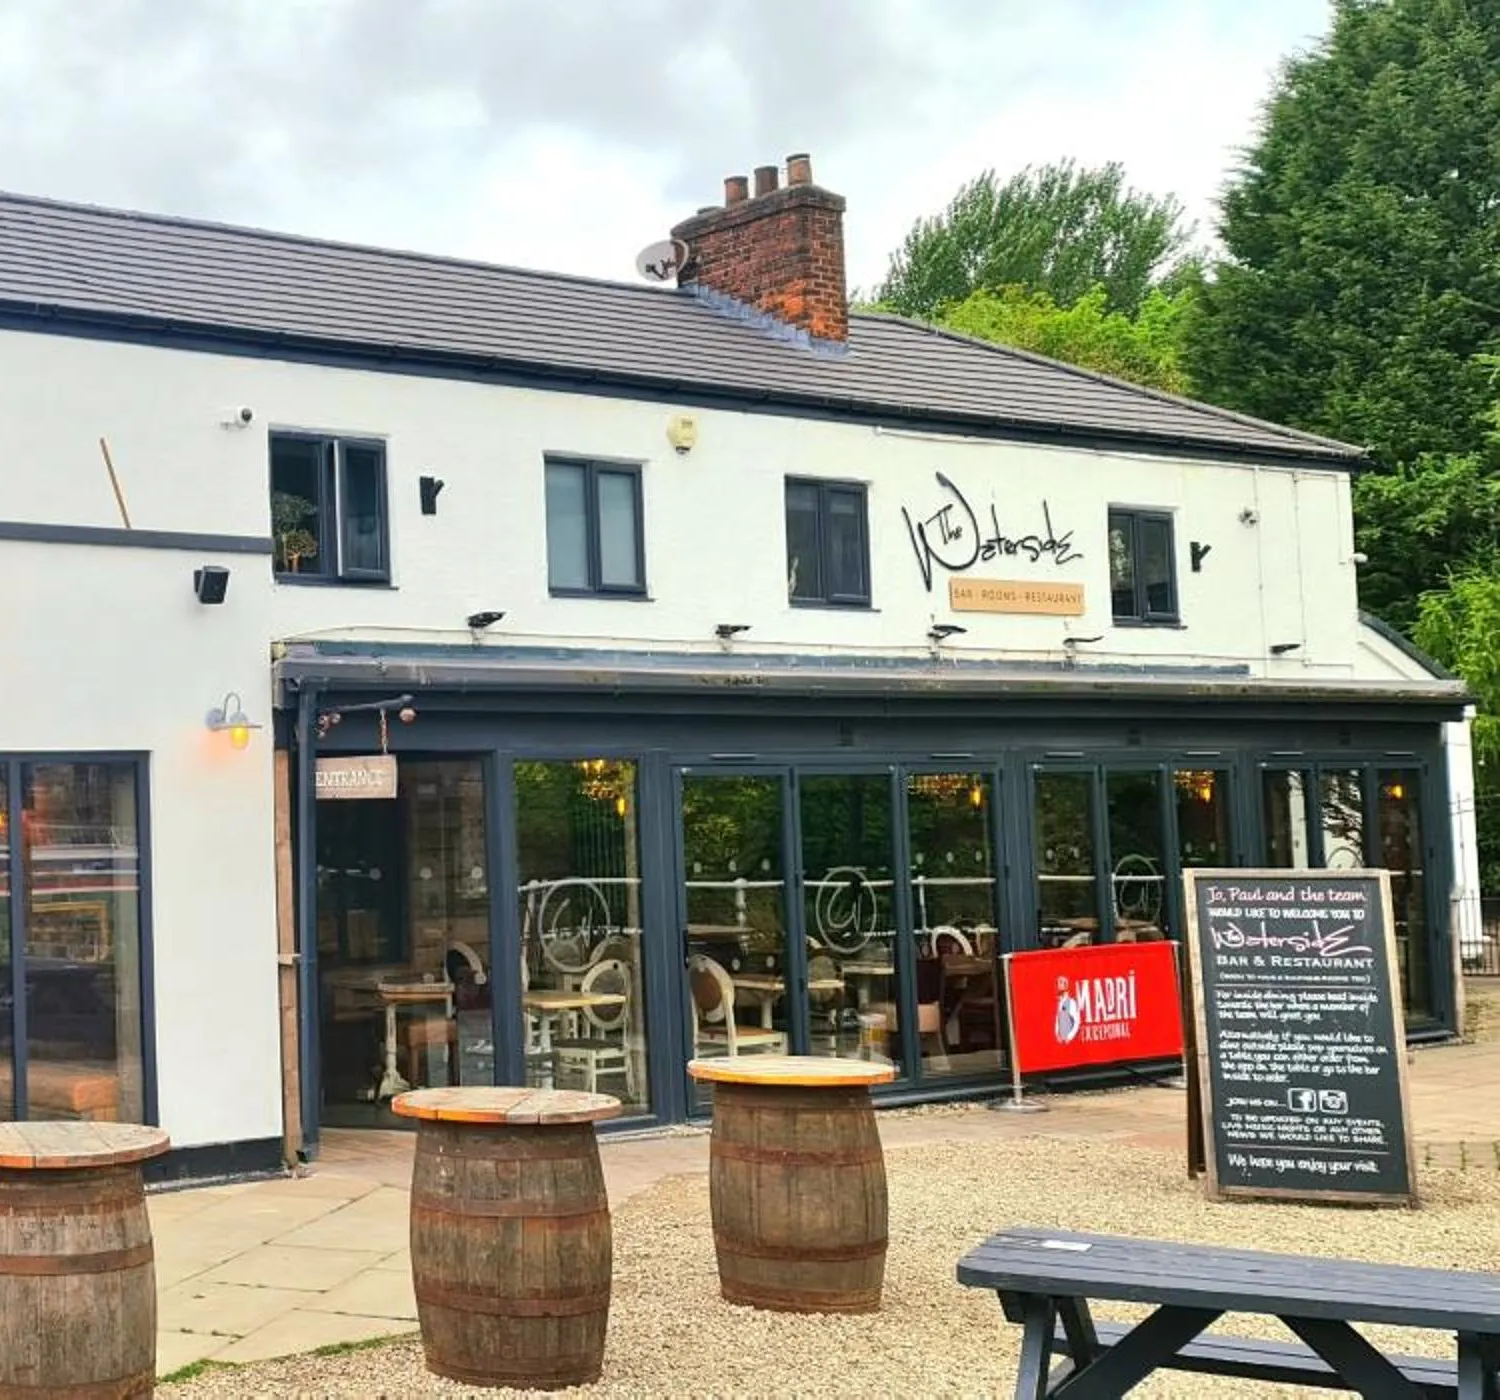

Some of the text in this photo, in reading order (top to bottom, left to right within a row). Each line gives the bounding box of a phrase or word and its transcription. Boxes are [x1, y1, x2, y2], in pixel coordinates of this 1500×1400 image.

[925, 504, 963, 545] The
[901, 471, 1084, 592] Waterside
[954, 588, 1081, 604] BAR ROOMS RESTAURANT
[315, 769, 387, 788] ENTRANCE
[1228, 887, 1263, 901] Paul
[1266, 886, 1294, 901] and
[1300, 886, 1325, 901] the
[1329, 888, 1368, 902] team
[1208, 908, 1365, 920] WOULD LIKE TO WELCOME YOU TO
[1216, 955, 1374, 969] BAR & RESTAURANT
[1233, 990, 1262, 1000] inside
[1264, 991, 1296, 1004] dining
[1299, 991, 1326, 1002] please
[1327, 991, 1346, 1002] head
[1219, 1010, 1234, 1020] the
[1235, 1011, 1258, 1020] team
[1259, 1011, 1277, 1020] will
[1255, 1001, 1269, 1010] the
[1270, 1001, 1284, 1010] bar
[1286, 1002, 1312, 1011] where
[1320, 1002, 1357, 1012] member
[1359, 1002, 1371, 1016] of
[1293, 1032, 1312, 1042] you
[1314, 1032, 1342, 1043] would
[1344, 1032, 1362, 1043] like
[1363, 1034, 1375, 1044] to
[1346, 1054, 1370, 1066] from
[1268, 1063, 1285, 1072] the
[1322, 1065, 1334, 1076] go
[1335, 1065, 1346, 1074] to
[1347, 1065, 1363, 1075] the
[1364, 1066, 1380, 1075] bar
[1252, 1073, 1264, 1082] to
[1230, 1113, 1242, 1122] TO
[1305, 1116, 1319, 1125] ON
[1312, 1125, 1326, 1133] OR
[1278, 1132, 1312, 1141] WOULD
[1313, 1134, 1336, 1142] LIKE
[1338, 1134, 1350, 1143] TO
[1227, 1153, 1247, 1167] We
[1249, 1154, 1274, 1169] hope
[1275, 1158, 1296, 1173] you
[1297, 1157, 1327, 1174] enjoy
[1328, 1160, 1353, 1175] your
